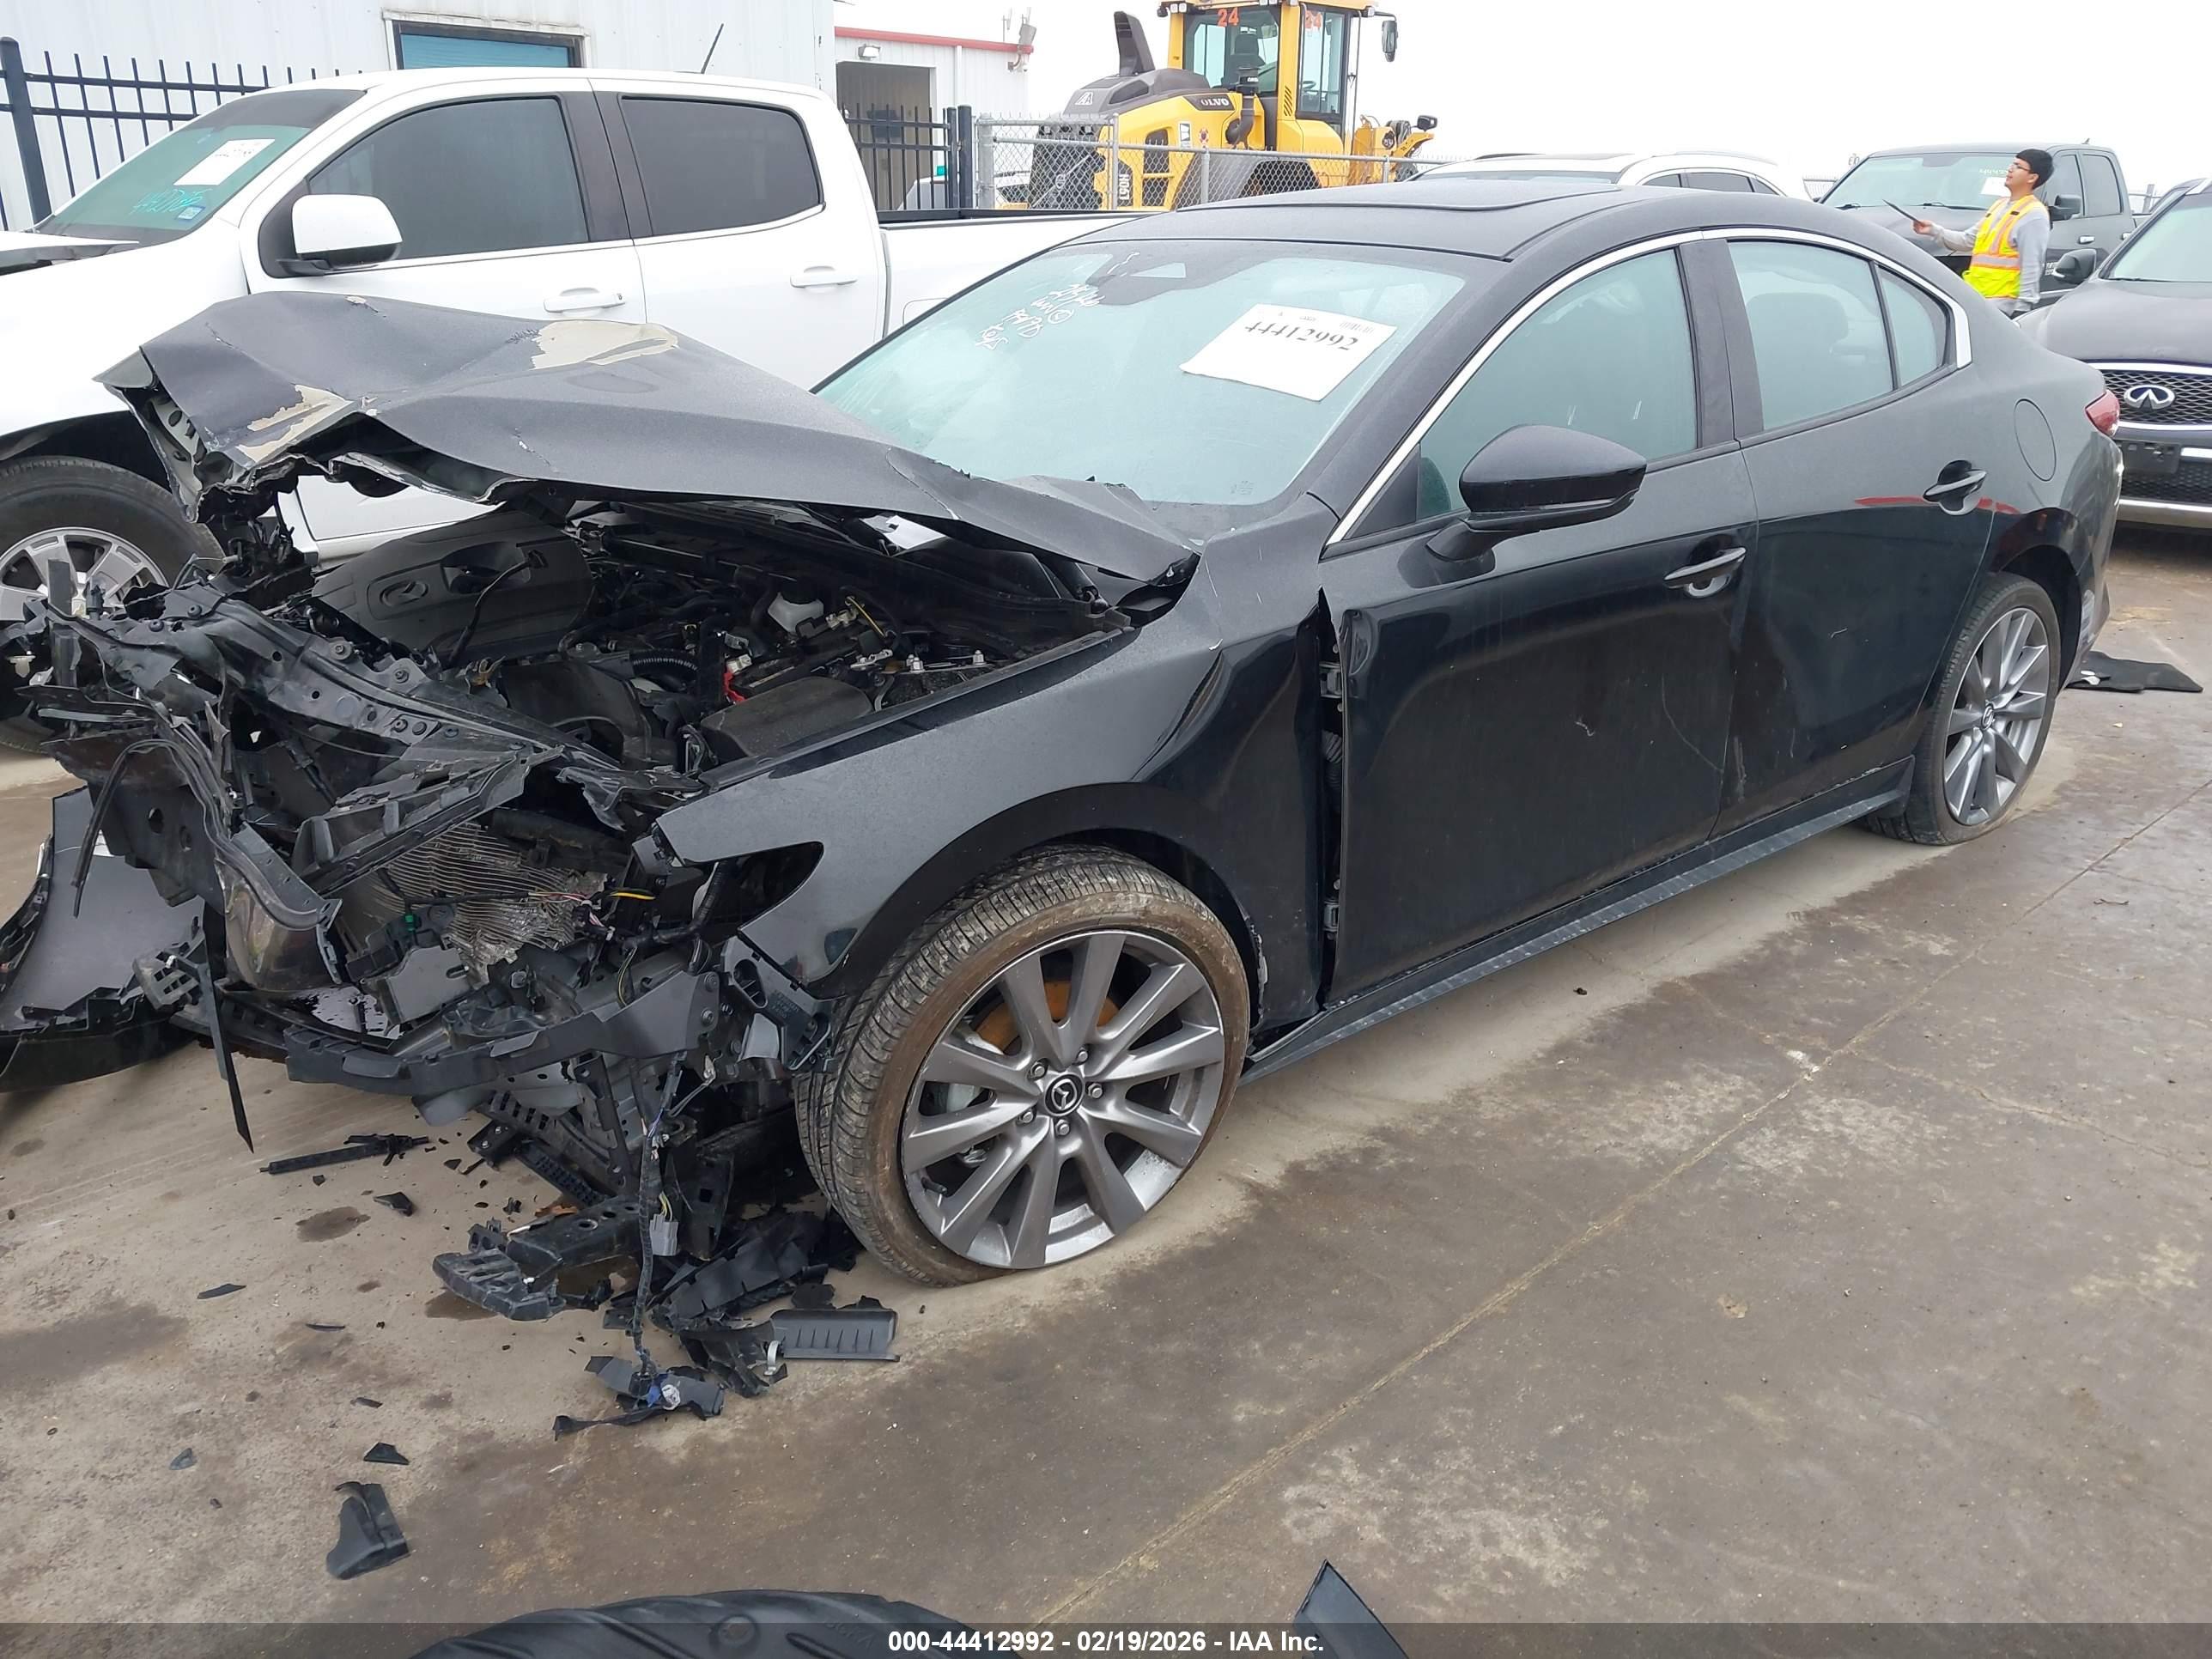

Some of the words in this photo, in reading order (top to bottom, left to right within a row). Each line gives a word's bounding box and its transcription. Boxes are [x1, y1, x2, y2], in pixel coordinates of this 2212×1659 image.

[1217, 8, 1239, 27] 24
[1194, 98, 1230, 106] OLVO
[1245, 321, 1358, 350] 44412992
